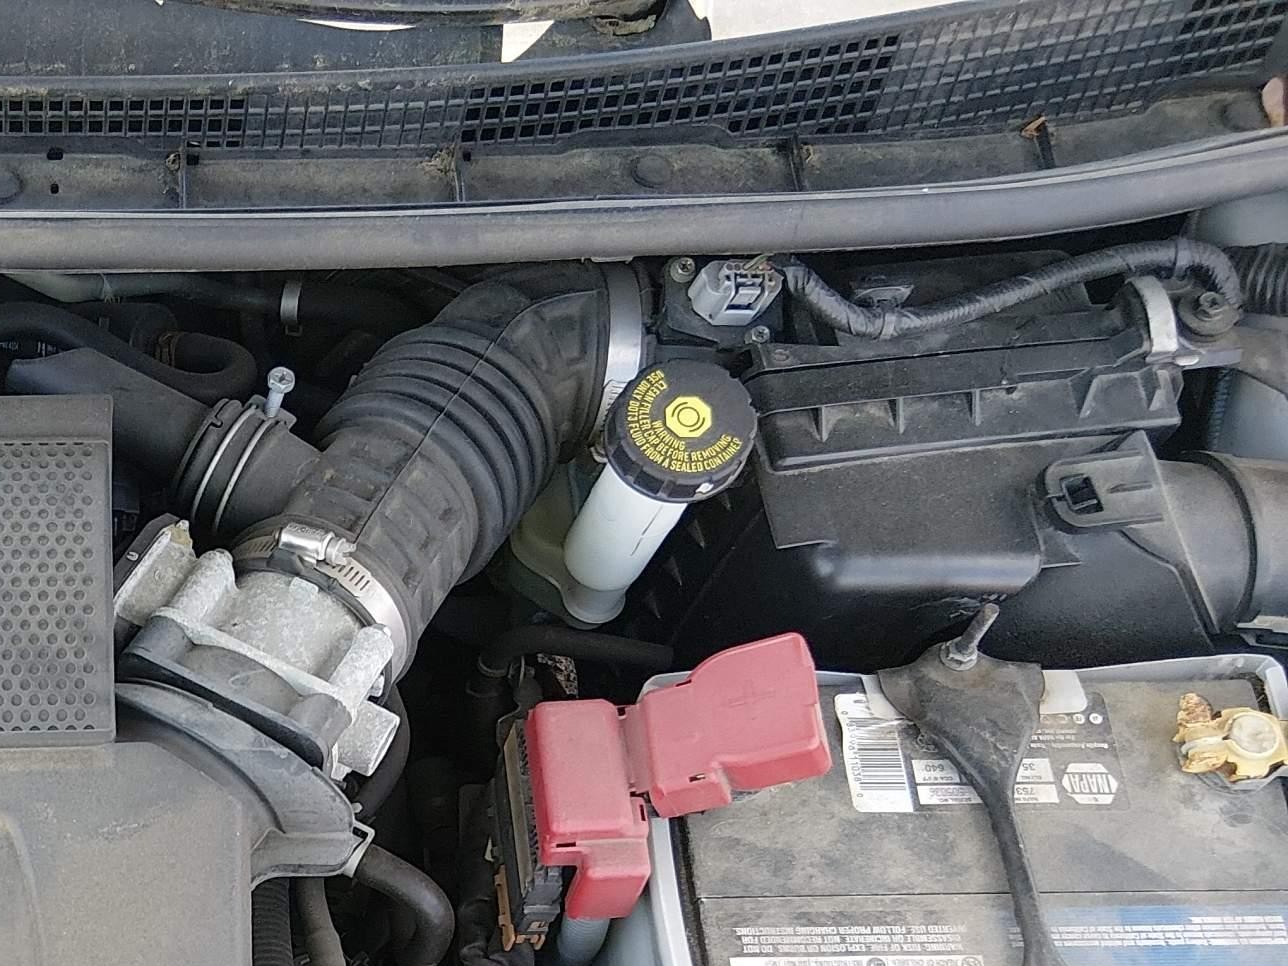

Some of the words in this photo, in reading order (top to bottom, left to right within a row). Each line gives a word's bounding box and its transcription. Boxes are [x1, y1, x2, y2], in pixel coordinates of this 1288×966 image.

[646, 370, 664, 384] USE
[632, 380, 650, 400] ONLY
[643, 380, 667, 403] CLEAN
[639, 402, 651, 431] FILLER
[628, 423, 646, 447] FLUID
[644, 430, 660, 444] CAP
[652, 420, 685, 450] WARNING
[640, 443, 665, 464] FROM
[656, 442, 690, 461] BEFORE
[703, 437, 743, 470] CONTAINER
[662, 458, 670, 468] A
[669, 460, 704, 473] SEALED
[925, 764, 944, 772] 640
[1022, 762, 1036, 771] 35
[1069, 774, 1110, 793] NAPA
